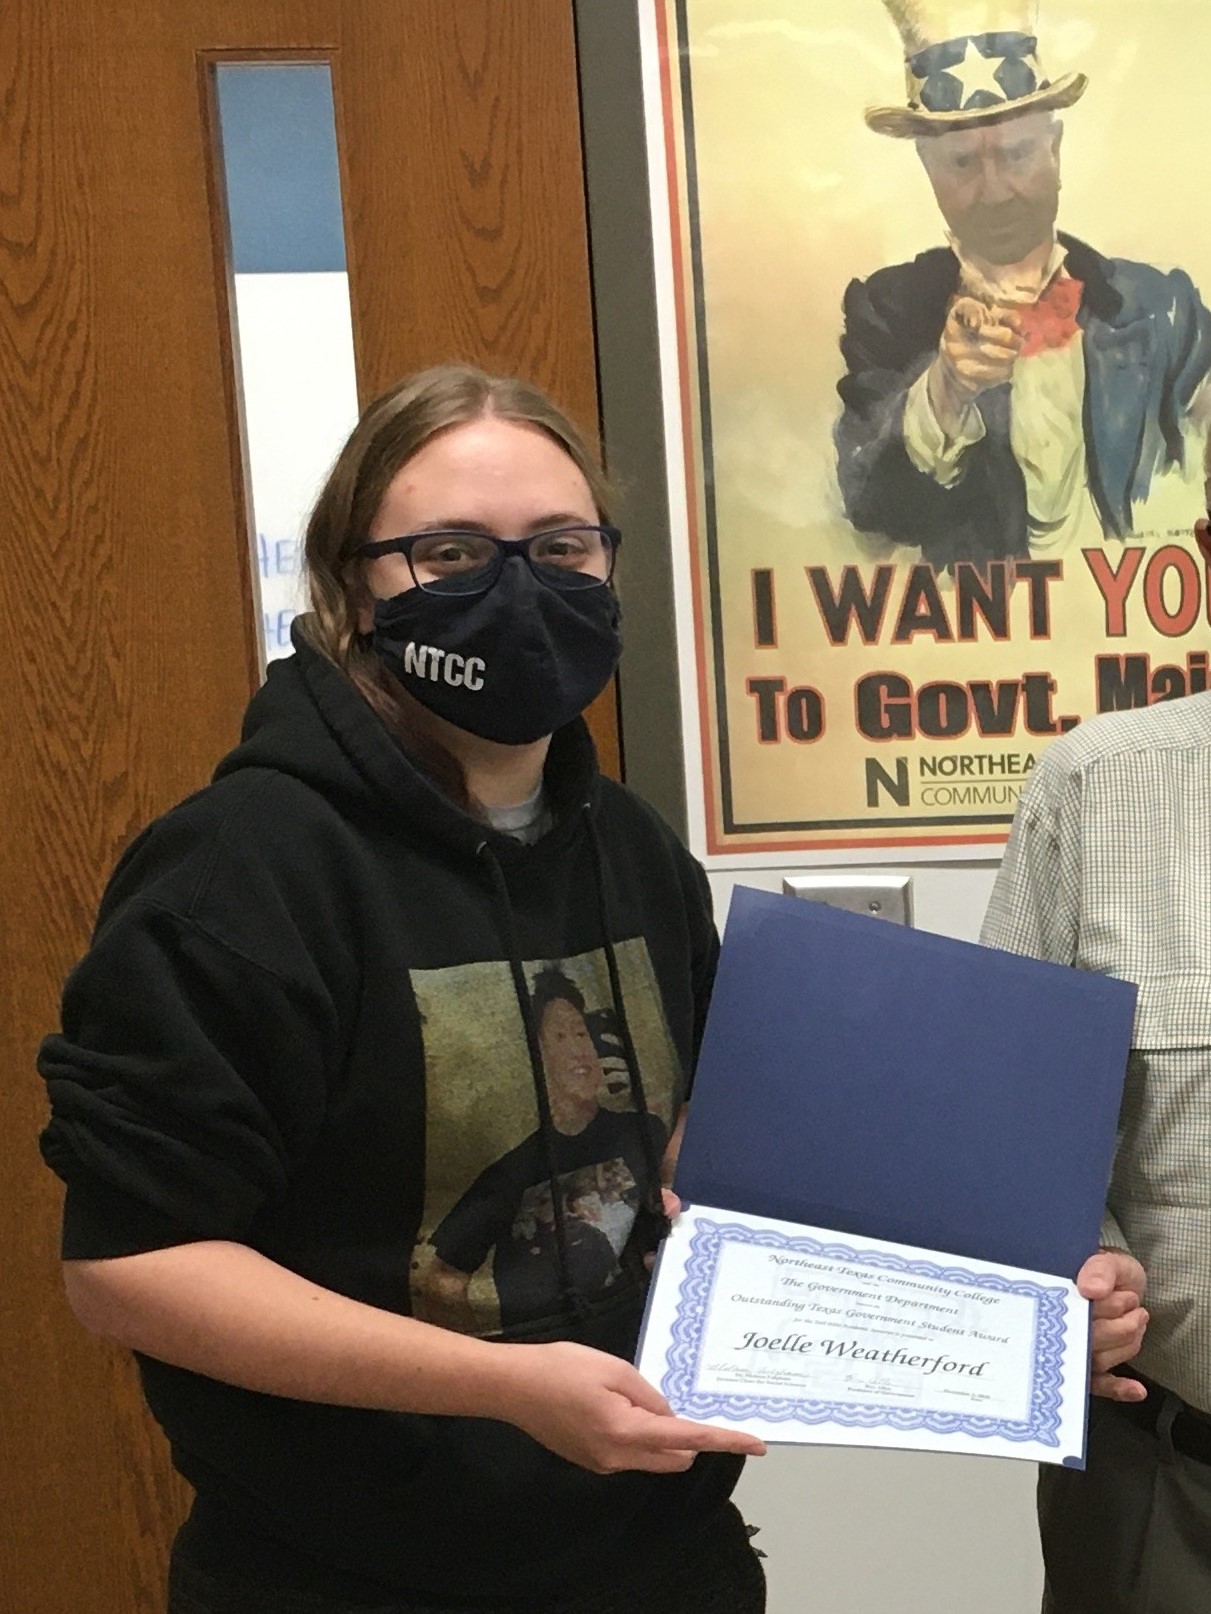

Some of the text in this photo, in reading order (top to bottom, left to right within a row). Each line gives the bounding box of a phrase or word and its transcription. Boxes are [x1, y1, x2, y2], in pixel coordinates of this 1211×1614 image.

[751, 567, 778, 649] I
[805, 559, 1064, 647] WANT
[405, 641, 486, 691] NTCC
[746, 676, 824, 744] To
[855, 671, 1081, 743] Govt.
[920, 753, 1036, 777] NORTHEA
[921, 785, 1025, 806] COMMUN
[768, 1254, 1001, 1305] Northeast Texas Community College
[781, 1276, 959, 1315] The Government Department
[730, 1294, 805, 1312] Outstanding
[808, 1302, 842, 1315] Texas
[844, 1308, 916, 1326] Government
[918, 1320, 965, 1336] Student
[968, 1329, 1011, 1344] Award
[734, 1332, 813, 1354] Joelle
[819, 1339, 990, 1376] Weatherford
